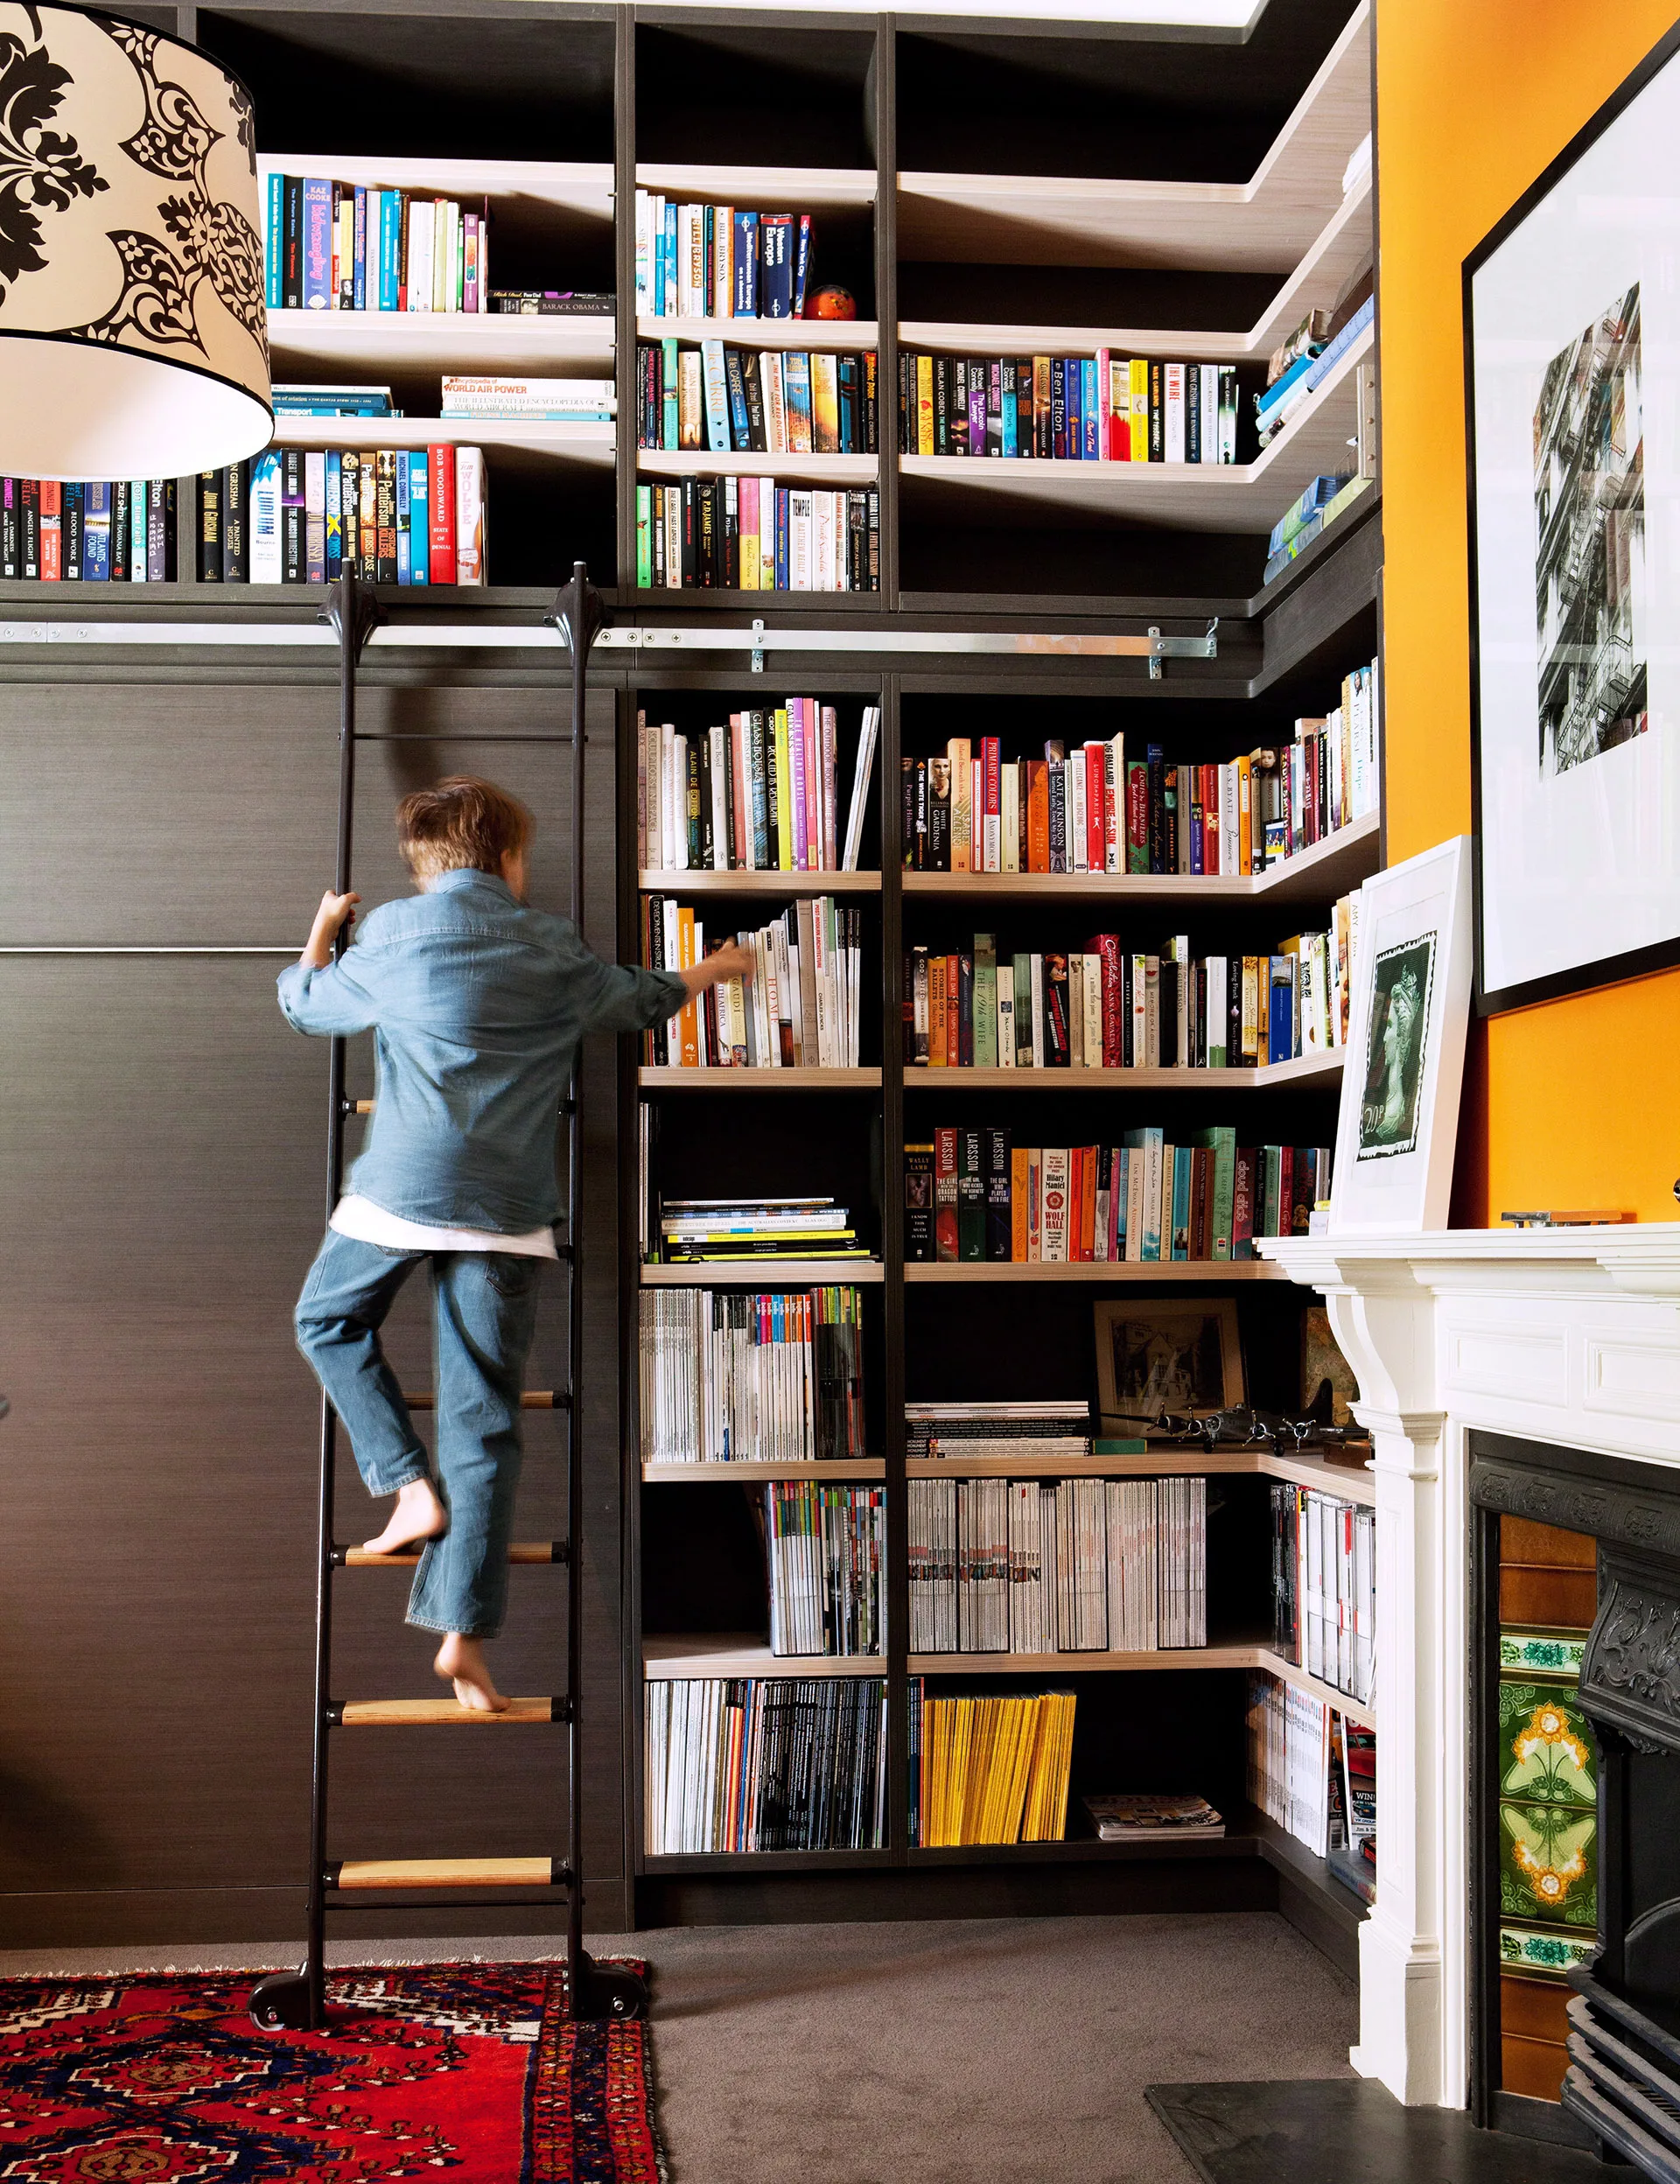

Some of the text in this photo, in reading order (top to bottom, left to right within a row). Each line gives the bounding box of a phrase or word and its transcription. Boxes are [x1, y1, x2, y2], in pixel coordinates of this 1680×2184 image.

[306, 193, 331, 202] COOKE
[308, 205, 326, 280] kidwrangling
[692, 220, 702, 288] BILL BRYSON
[766, 227, 785, 267] Western Europe
[494, 385, 528, 394] POWER
[956, 362, 965, 410] MICHAEL CONNELLY
[991, 387, 1000, 411] CONNELLY
[1054, 371, 1064, 431] Ben Elton
[1169, 367, 1180, 401] THE WIRE
[1189, 367, 1198, 408] JOHN GRISHAM
[276, 407, 312, 416] Transport
[230, 472, 239, 509] GRISHAM
[288, 452, 298, 495] ROBERT LUDLUM
[342, 472, 356, 515] Patterson
[361, 464, 373, 514] Patterson
[4, 479, 12, 509] CONNELLY
[257, 491, 274, 535] LUDLUM
[328, 475, 340, 515] PATTERSON
[379, 480, 392, 527] Patterson
[203, 491, 218, 542] JOHN GRISHAM
[288, 508, 298, 565] THE JANSON DIRECTIVE
[88, 536, 97, 558] FOUND
[97, 533, 106, 563] ATLANTIS
[308, 513, 323, 564] DI MORRISSEY
[328, 536, 340, 559] CROSS
[364, 529, 374, 571] WORST CASE
[379, 528, 388, 558] KILLERS
[752, 714, 763, 783] GLASS HOUSES
[1104, 743, 1114, 785] JG BALLARD
[648, 731, 657, 832] SCULPTORS IN SPACE
[690, 777, 697, 787] DE
[988, 741, 998, 809] PRIMARY COLORS
[1354, 759, 1364, 793] Hope
[1051, 824, 1057, 833] My
[1105, 788, 1116, 845] EMPIRE SUN
[1105, 939, 1118, 989] Consolation
[718, 999, 727, 1027] AFRICA
[732, 977, 744, 1013] GAUDÍ
[768, 977, 779, 1025] HOME
[939, 1001, 944, 1011] OF
[976, 993, 987, 1016] 19th
[942, 1131, 953, 1171] LARSSON
[967, 1133, 978, 1172] LARSSON
[992, 1132, 1004, 1170] LARSSON
[1236, 1160, 1250, 1222] cloud atlas
[1046, 1211, 1065, 1220] WOLF
[1046, 1221, 1064, 1229] HALL
[1356, 1792, 1376, 1801] WIN!
